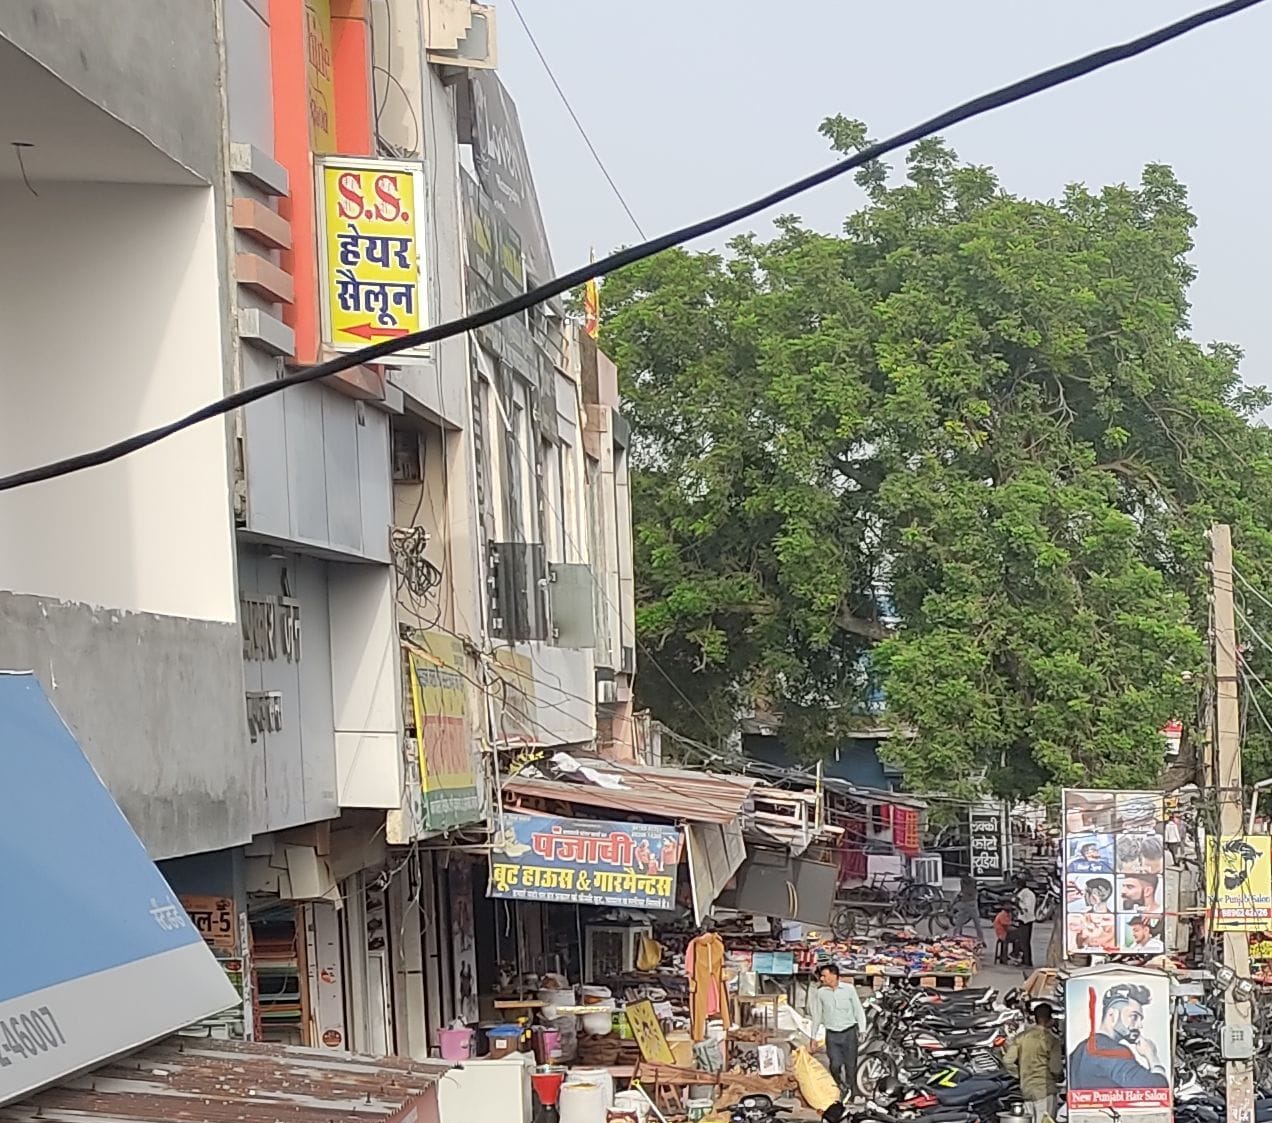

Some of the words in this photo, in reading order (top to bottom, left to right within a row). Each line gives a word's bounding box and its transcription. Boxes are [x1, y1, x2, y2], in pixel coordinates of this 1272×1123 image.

[338, 172, 410, 222] S.S.
[337, 224, 412, 269] हेयर
[336, 268, 415, 326] सैलून
[493, 863, 521, 893] बूट
[522, 866, 576, 890] हाऊस
[576, 870, 592, 892] &
[1071, 1091, 1092, 1101] New
[1093, 1091, 1125, 1104] Punjabi
[1125, 1091, 1144, 1101] Hair
[1144, 1091, 1168, 1101] Salon
